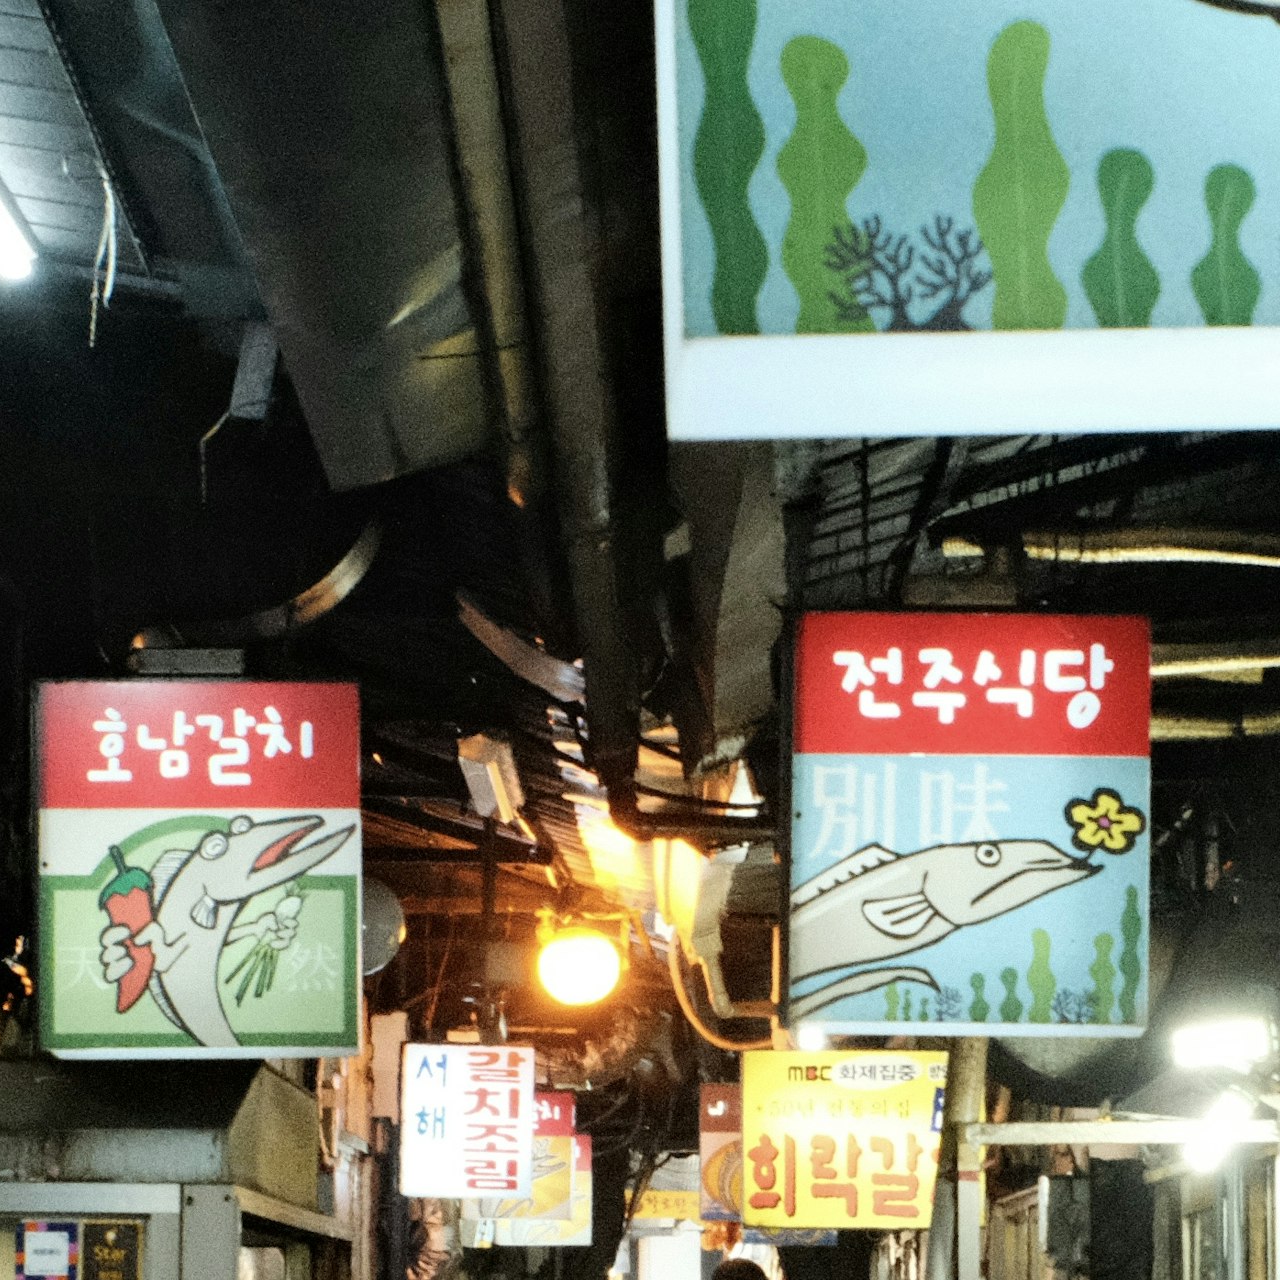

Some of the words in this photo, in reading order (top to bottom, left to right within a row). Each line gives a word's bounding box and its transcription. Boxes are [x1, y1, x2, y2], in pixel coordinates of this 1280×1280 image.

[833, 643, 1114, 730] 전주식당
[86, 705, 315, 786] 호남갈치
[808, 762, 1010, 860] 別味
[415, 1053, 450, 1139] 서해
[839, 1063, 916, 1081] 화제집중
[463, 1051, 520, 1192] 갈치조림
[747, 1133, 939, 1218] 희락갈
